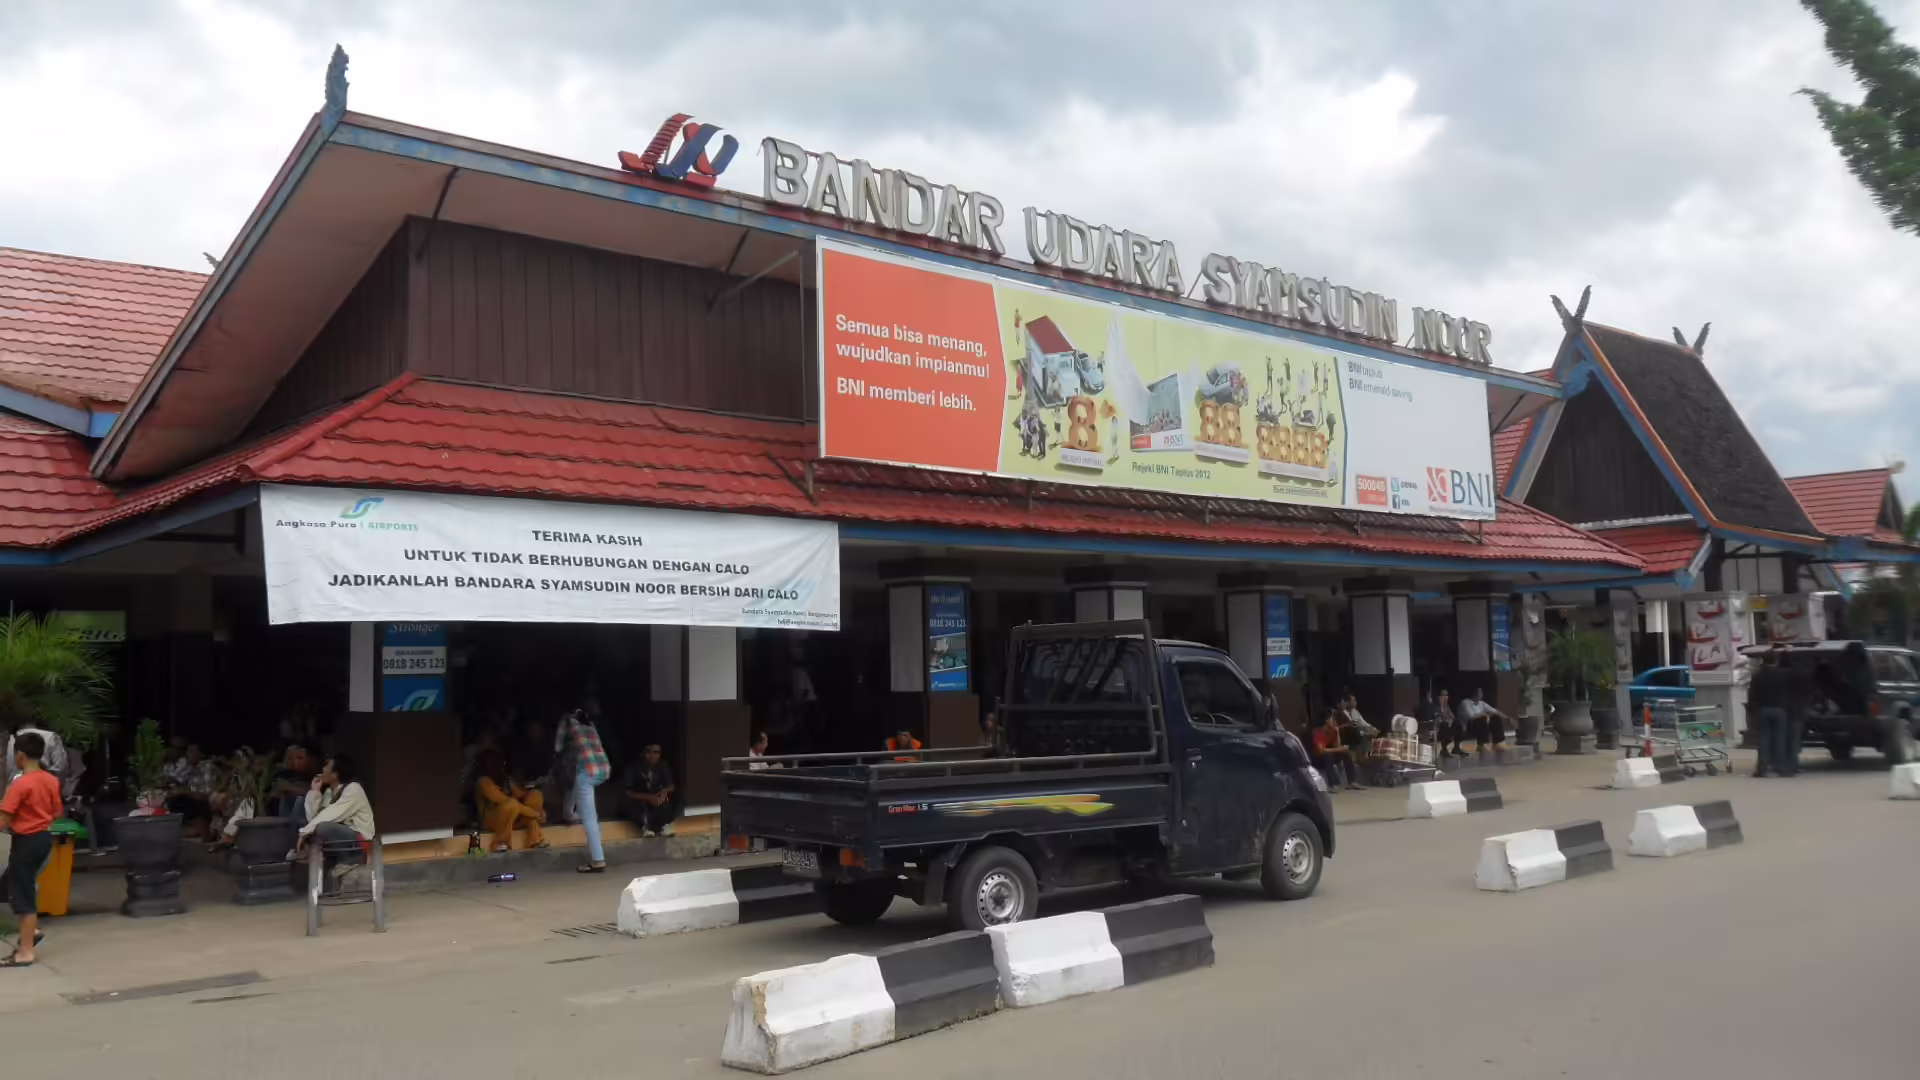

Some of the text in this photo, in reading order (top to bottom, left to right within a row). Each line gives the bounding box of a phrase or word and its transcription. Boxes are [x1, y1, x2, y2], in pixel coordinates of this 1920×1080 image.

[763, 137, 1493, 365] BANDAR UDARA SYAMSUDIN NOOR
[836, 313, 988, 358] Semua bisa menang,
[836, 342, 990, 379] wujudkan impianmu!
[836, 376, 977, 411] BNI memberi lebih.
[1349, 378, 1363, 390] BNI
[1131, 461, 1155, 474] Rejeki
[1156, 464, 1169, 475] BNI
[1195, 468, 1212, 480] 2012
[1449, 469, 1494, 508] BNI
[275, 519, 327, 529] Angkasa
[532, 530, 643, 547] TERIMA KASIH
[404, 549, 750, 575] UNTUK TIDAK BERHUBUNGAN DENGAN CALO
[328, 573, 799, 601] JADIKANLAH BANDARA SYAMSUDIN NOOR BERSIH DARI CALO
[409, 658, 427, 669] 245
